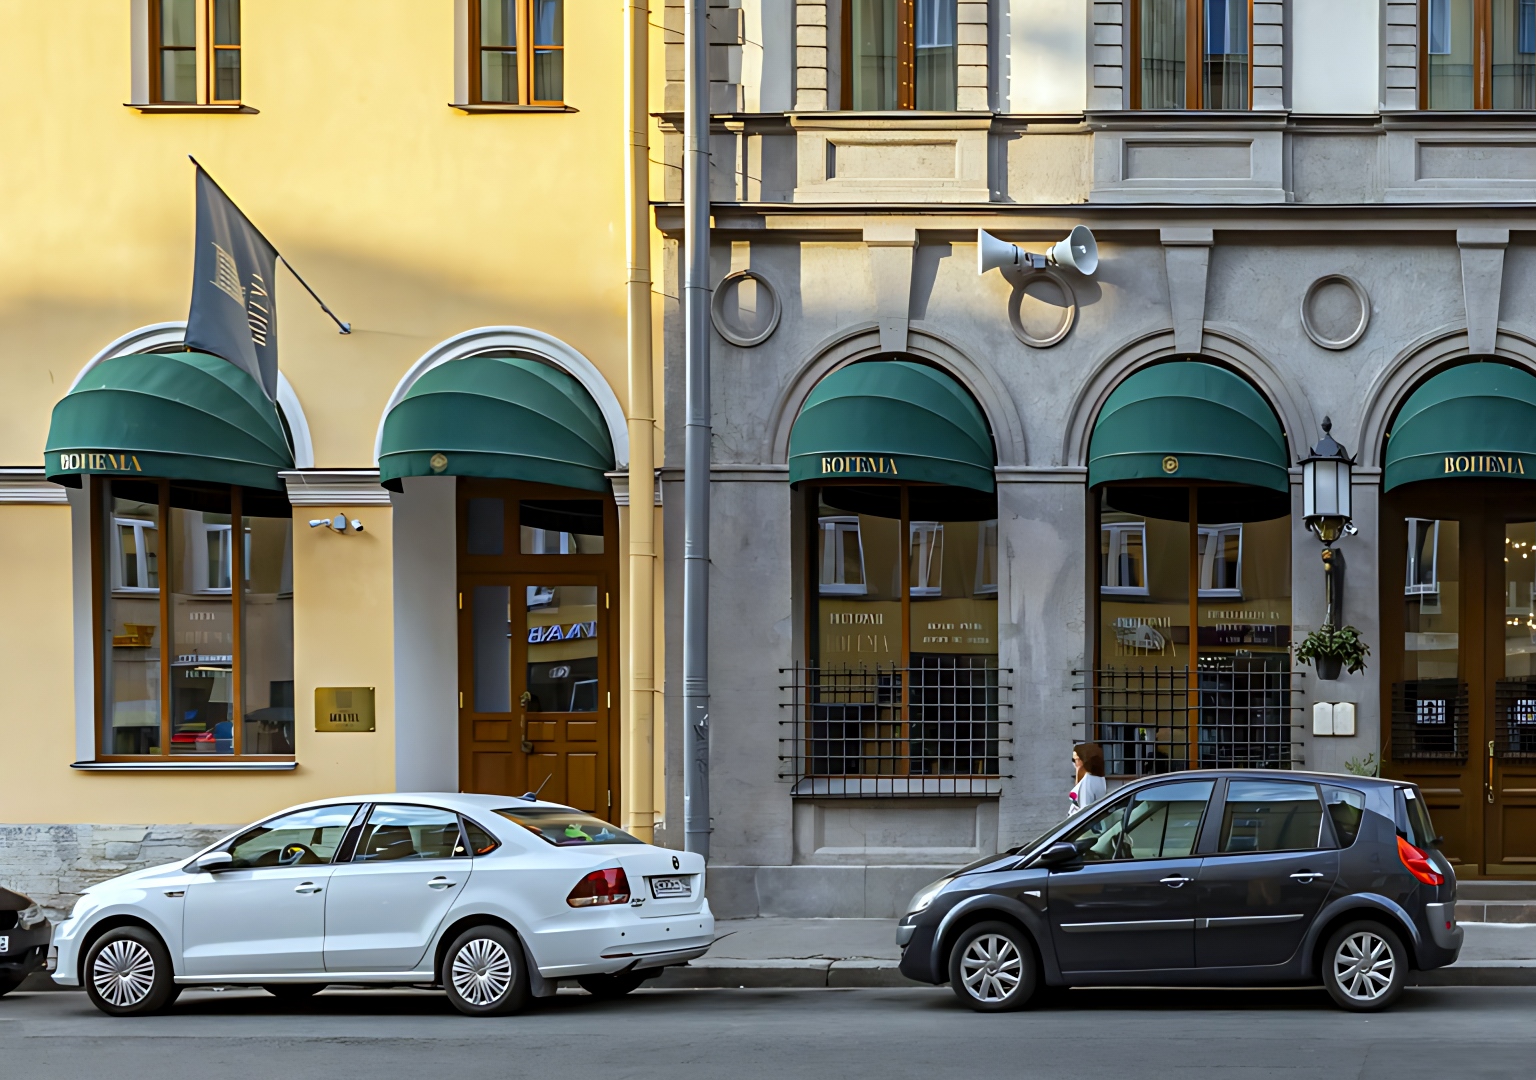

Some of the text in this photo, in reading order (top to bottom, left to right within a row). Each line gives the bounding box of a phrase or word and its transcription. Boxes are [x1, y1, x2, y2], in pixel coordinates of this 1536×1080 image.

[60, 453, 142, 472] BOHEMA
[821, 456, 898, 475] БОГЕМА
[1444, 455, 1525, 475] BOHEMA
